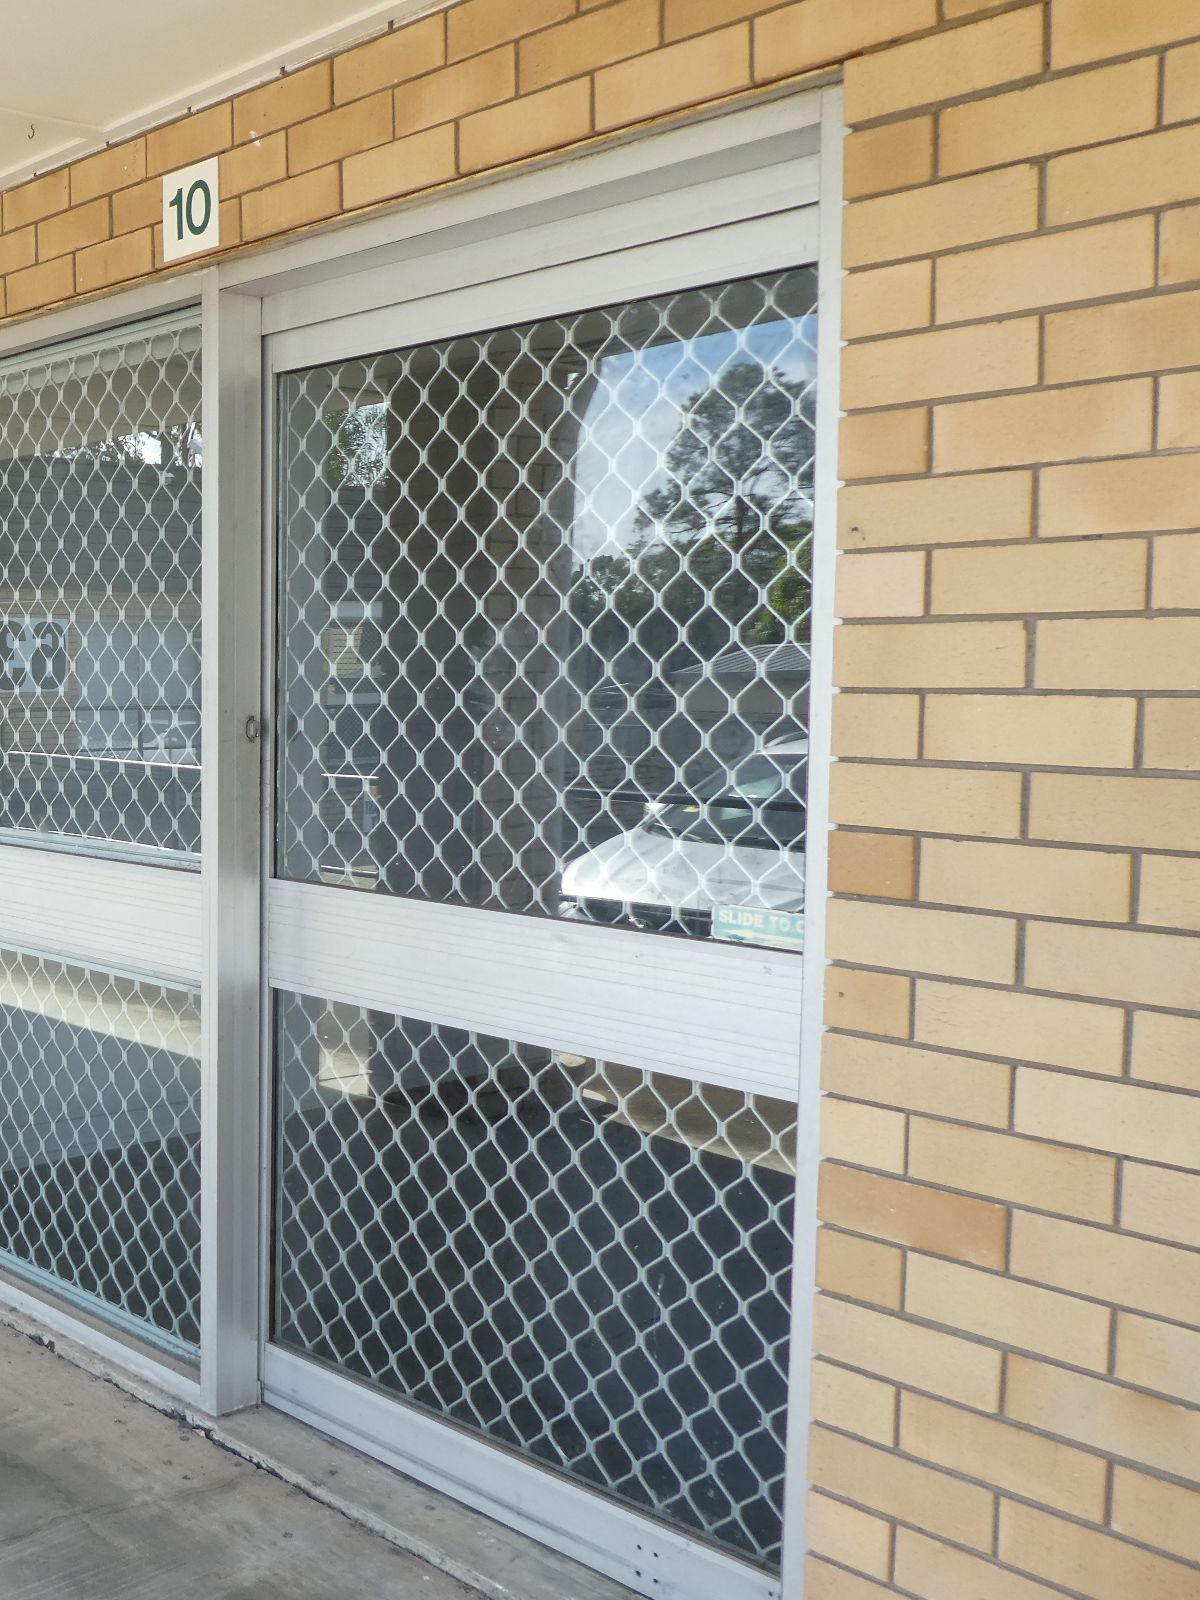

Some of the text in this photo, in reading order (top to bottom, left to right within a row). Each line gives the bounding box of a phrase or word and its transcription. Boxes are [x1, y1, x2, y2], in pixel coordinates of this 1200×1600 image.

[168, 179, 212, 241] 10
[719, 909, 764, 928] SLIDE
[770, 916, 791, 932] TO
